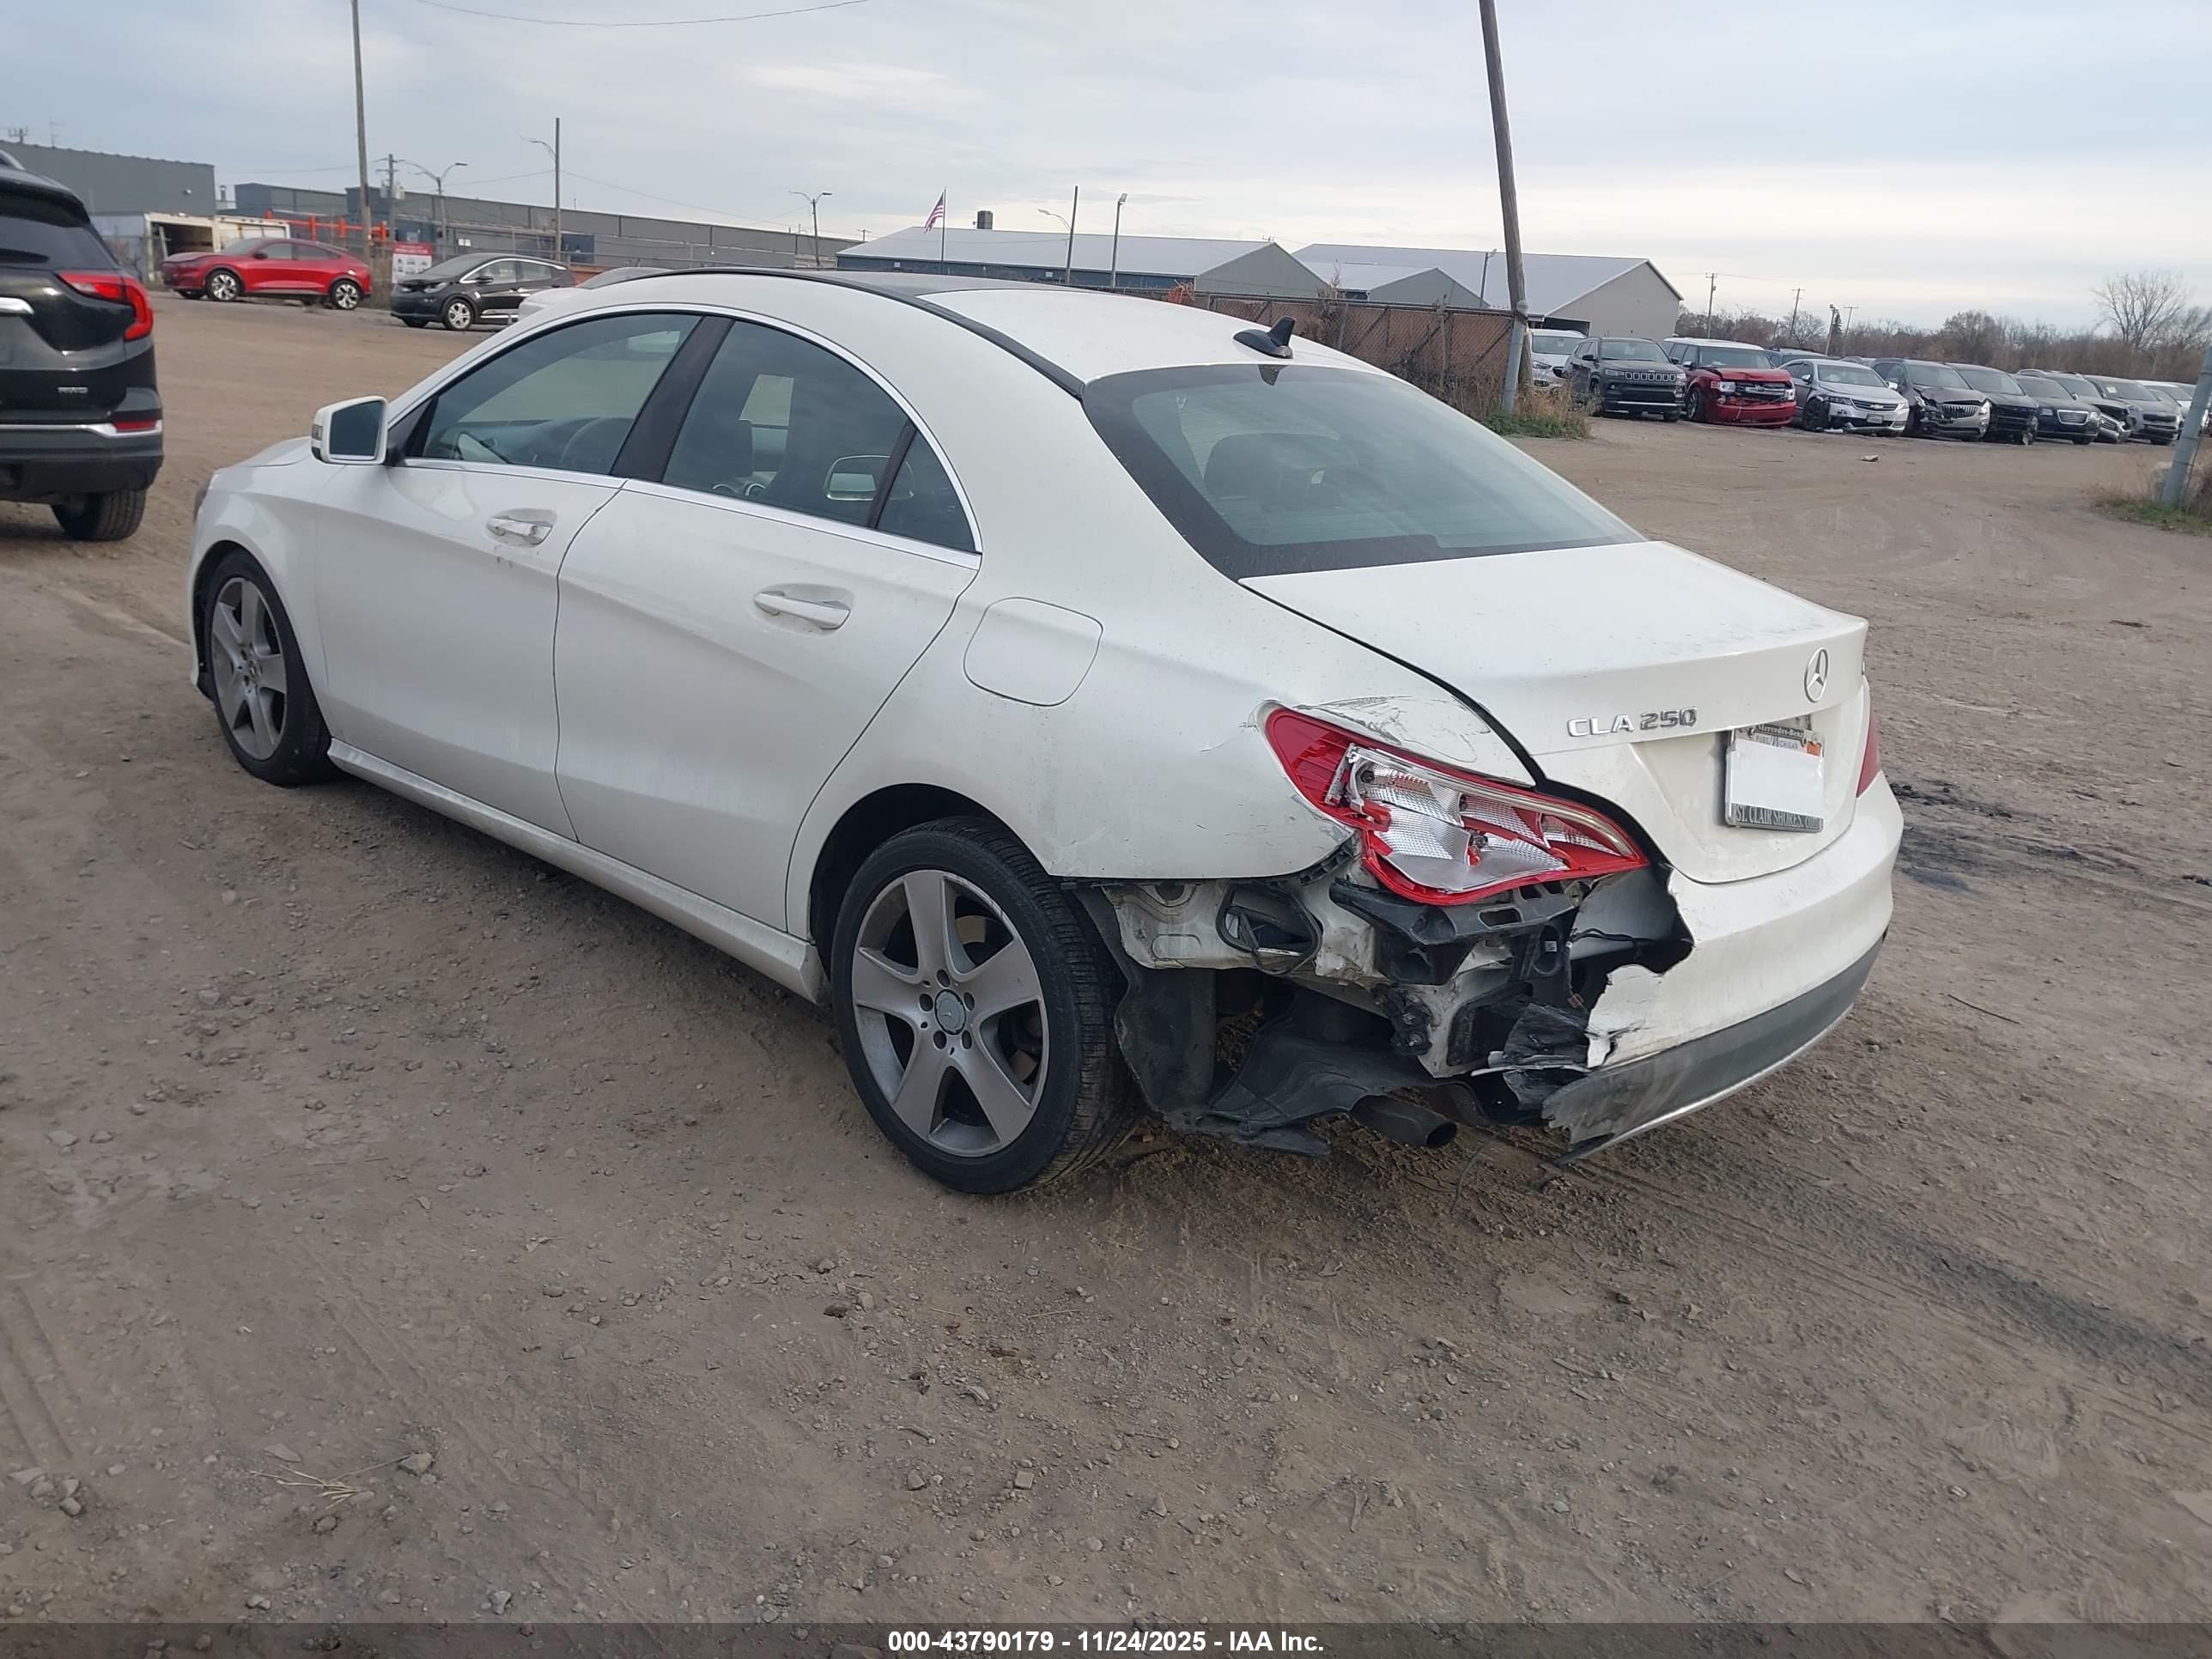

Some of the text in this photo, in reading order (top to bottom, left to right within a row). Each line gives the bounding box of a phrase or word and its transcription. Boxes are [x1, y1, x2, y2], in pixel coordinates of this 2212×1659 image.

[1567, 708, 1697, 737] CLA 250
[1758, 725, 1803, 738] Mercedes-Benz
